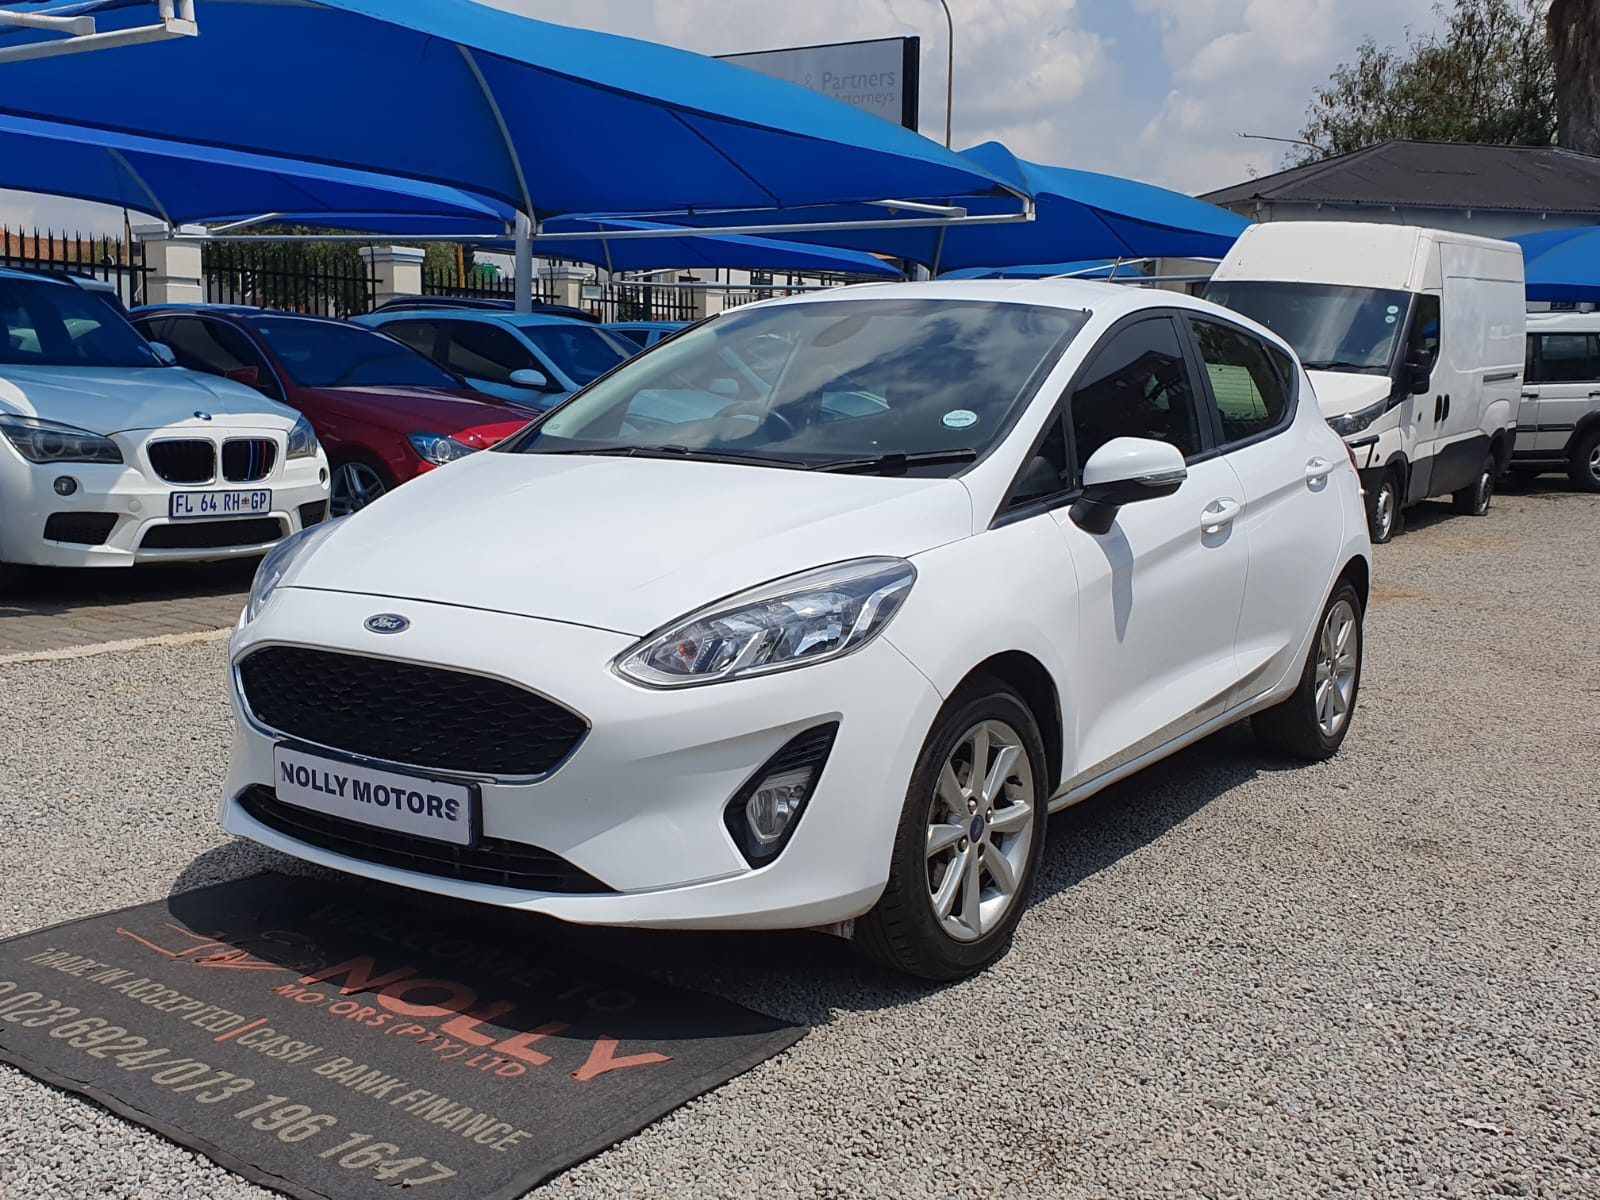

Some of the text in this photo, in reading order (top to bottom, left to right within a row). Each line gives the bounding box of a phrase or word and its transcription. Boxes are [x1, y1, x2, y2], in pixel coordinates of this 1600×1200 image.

[821, 71, 896, 91] Partners
[200, 493, 217, 512] 64
[223, 493, 240, 511] RH
[250, 491, 267, 510] GP
[280, 761, 460, 822] NOLLY MOTORS
[24, 947, 112, 977] TRADE
[86, 968, 136, 985] IN
[388, 1088, 534, 1151] FINANCE
[272, 983, 526, 1078] MOTORS (PTY) LTD
[299, 956, 674, 1082] NOLLY
[234, 1094, 338, 1143] 196
[319, 1131, 458, 1184] 1647
